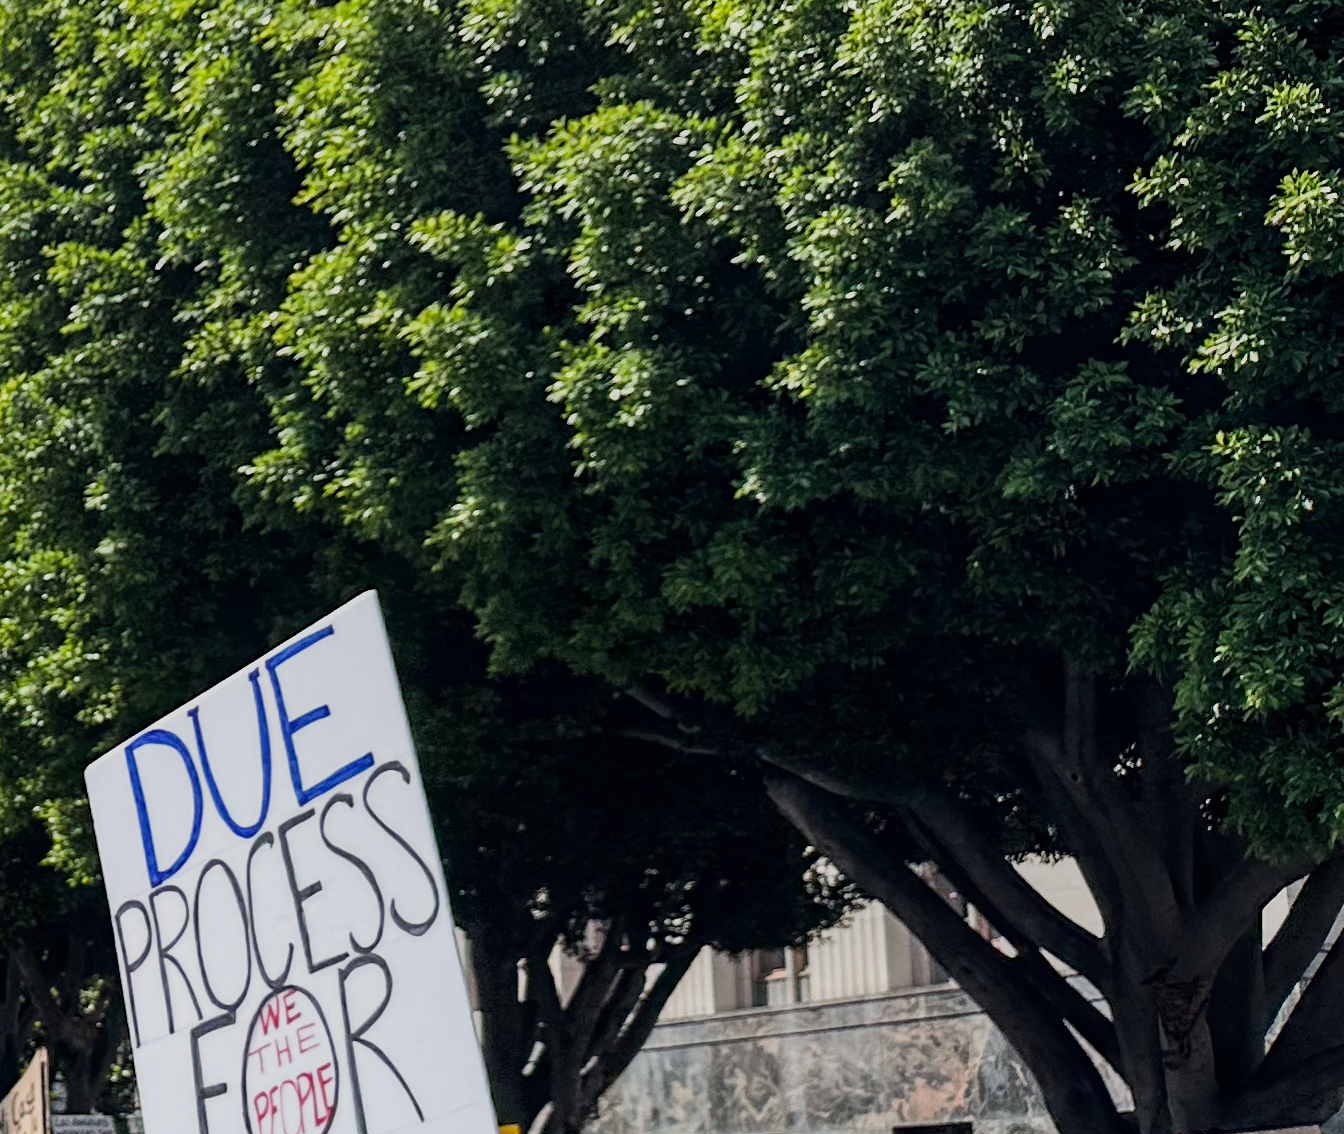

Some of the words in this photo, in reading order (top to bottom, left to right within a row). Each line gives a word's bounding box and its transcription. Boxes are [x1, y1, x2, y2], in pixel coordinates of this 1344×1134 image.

[125, 624, 374, 887] DUE
[115, 761, 439, 1047] PROCESS
[248, 1023, 320, 1073] THE
[260, 990, 301, 1035] WE
